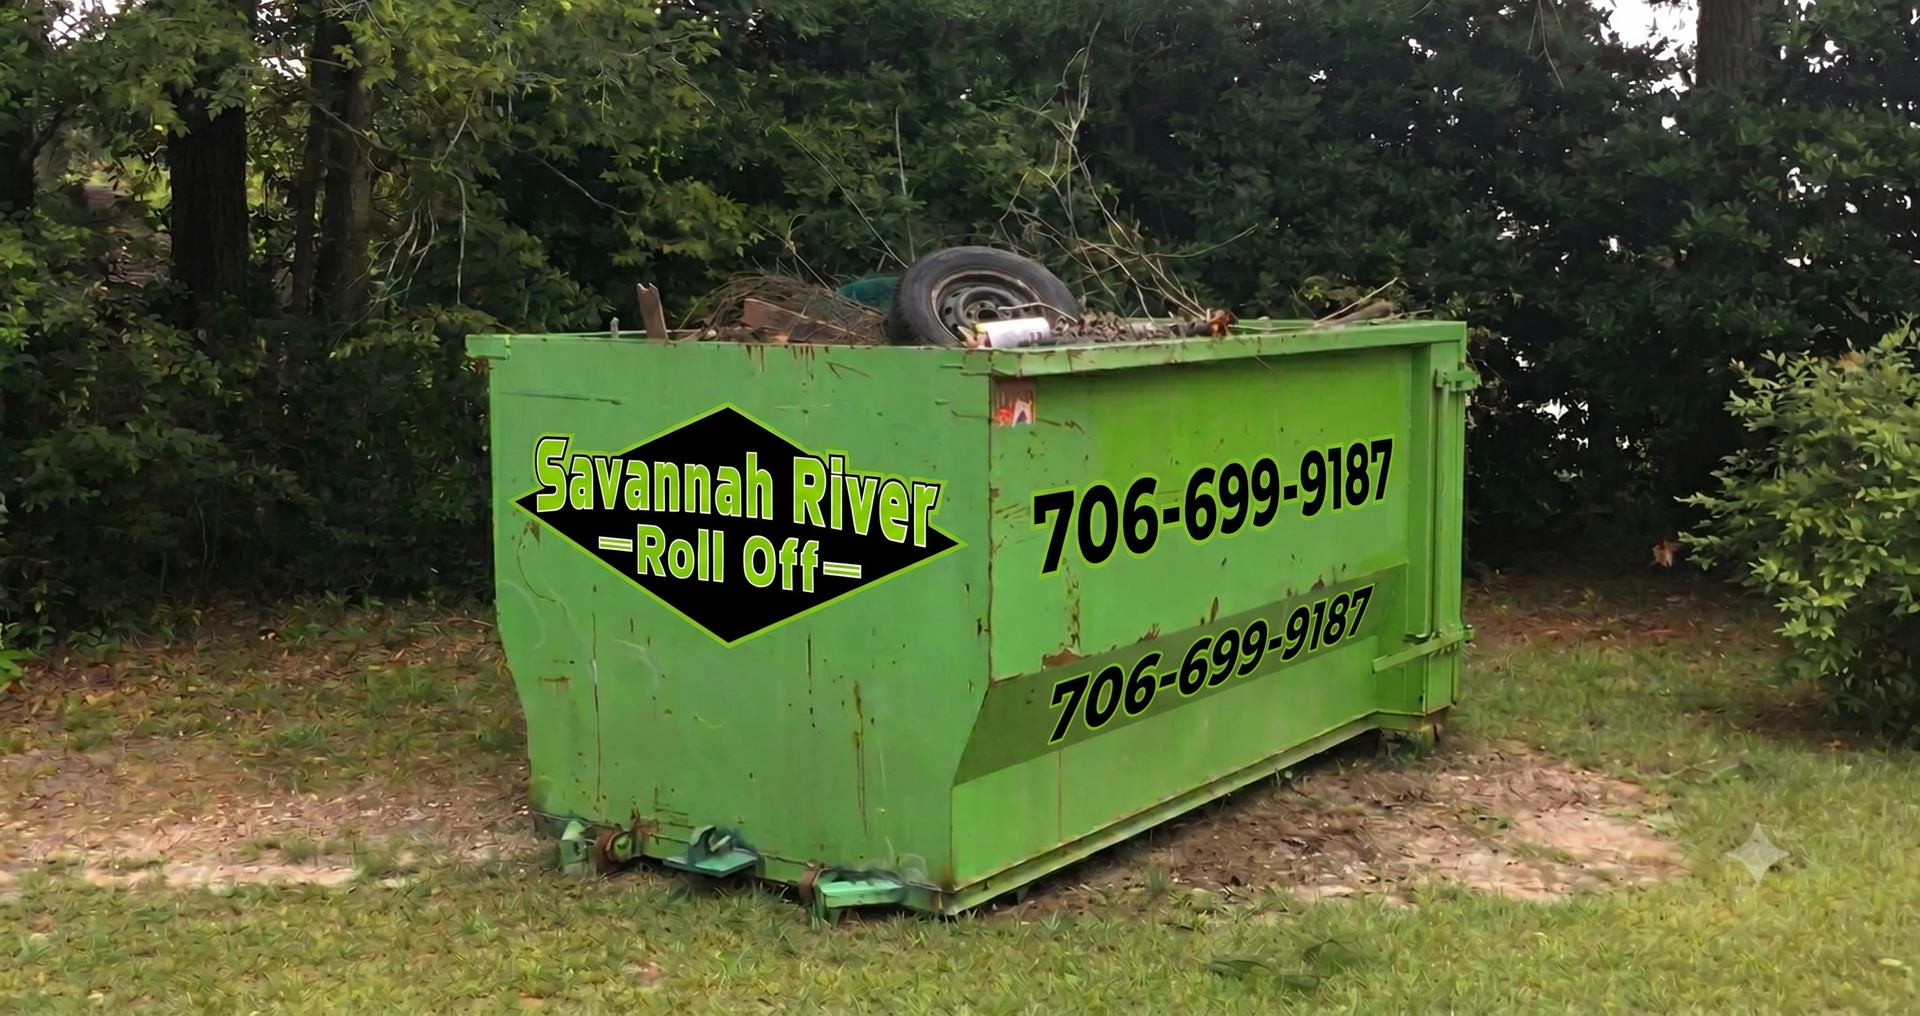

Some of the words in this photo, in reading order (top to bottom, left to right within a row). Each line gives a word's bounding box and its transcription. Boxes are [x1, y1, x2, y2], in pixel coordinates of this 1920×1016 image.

[535, 438, 773, 520] Savannah
[793, 454, 941, 547] River
[1033, 438, 1393, 575] 706-699-9187
[637, 524, 725, 582] Roll
[743, 535, 819, 593] Off
[1049, 583, 1376, 745] 706-699-9187
